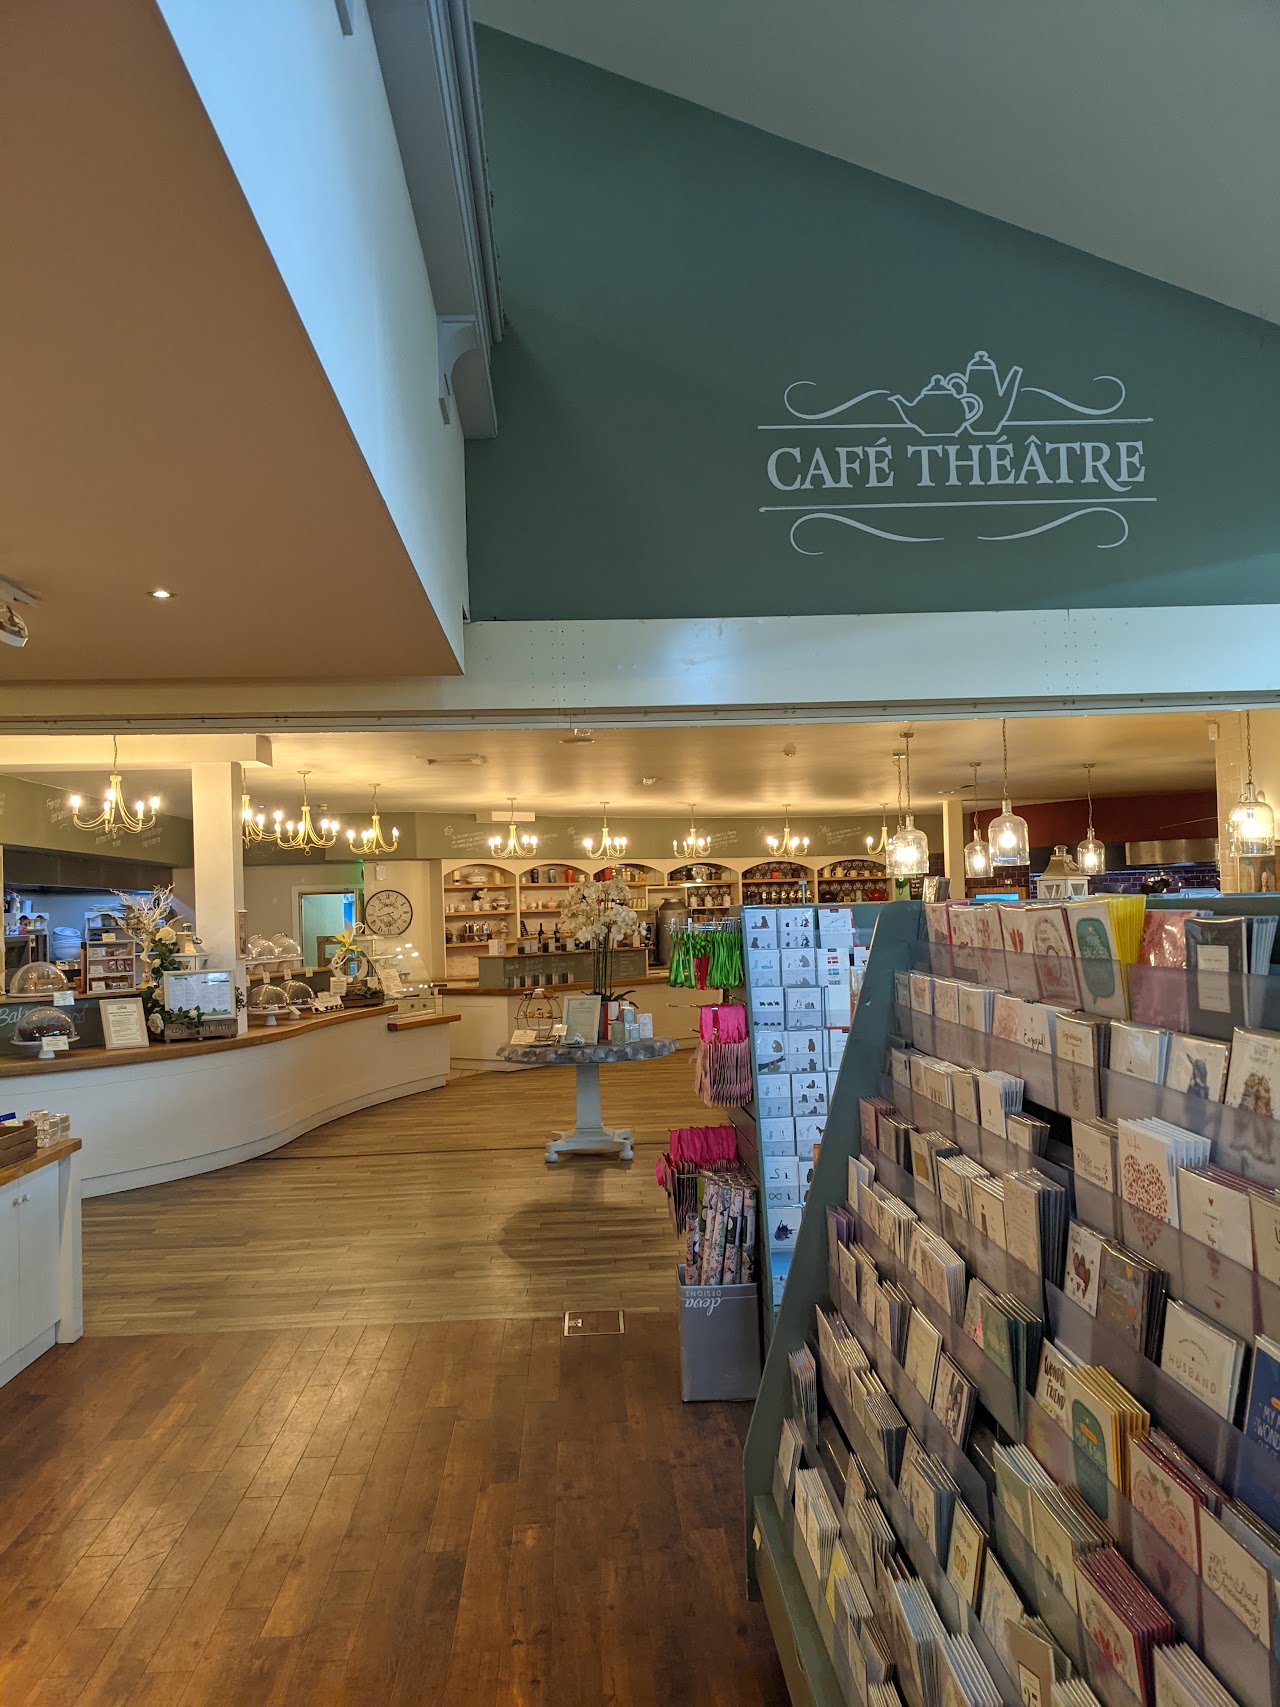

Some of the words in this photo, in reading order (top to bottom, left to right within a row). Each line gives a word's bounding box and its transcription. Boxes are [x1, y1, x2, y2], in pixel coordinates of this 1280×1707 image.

[767, 436, 894, 491] CAFÉ
[907, 434, 1146, 492] THÉÂTRE
[684, 1298, 722, 1317] deva
[685, 1290, 722, 1298] DESIGNS
[1168, 1352, 1217, 1394] HUSBAND
[1046, 1378, 1066, 1411] FRIEND
